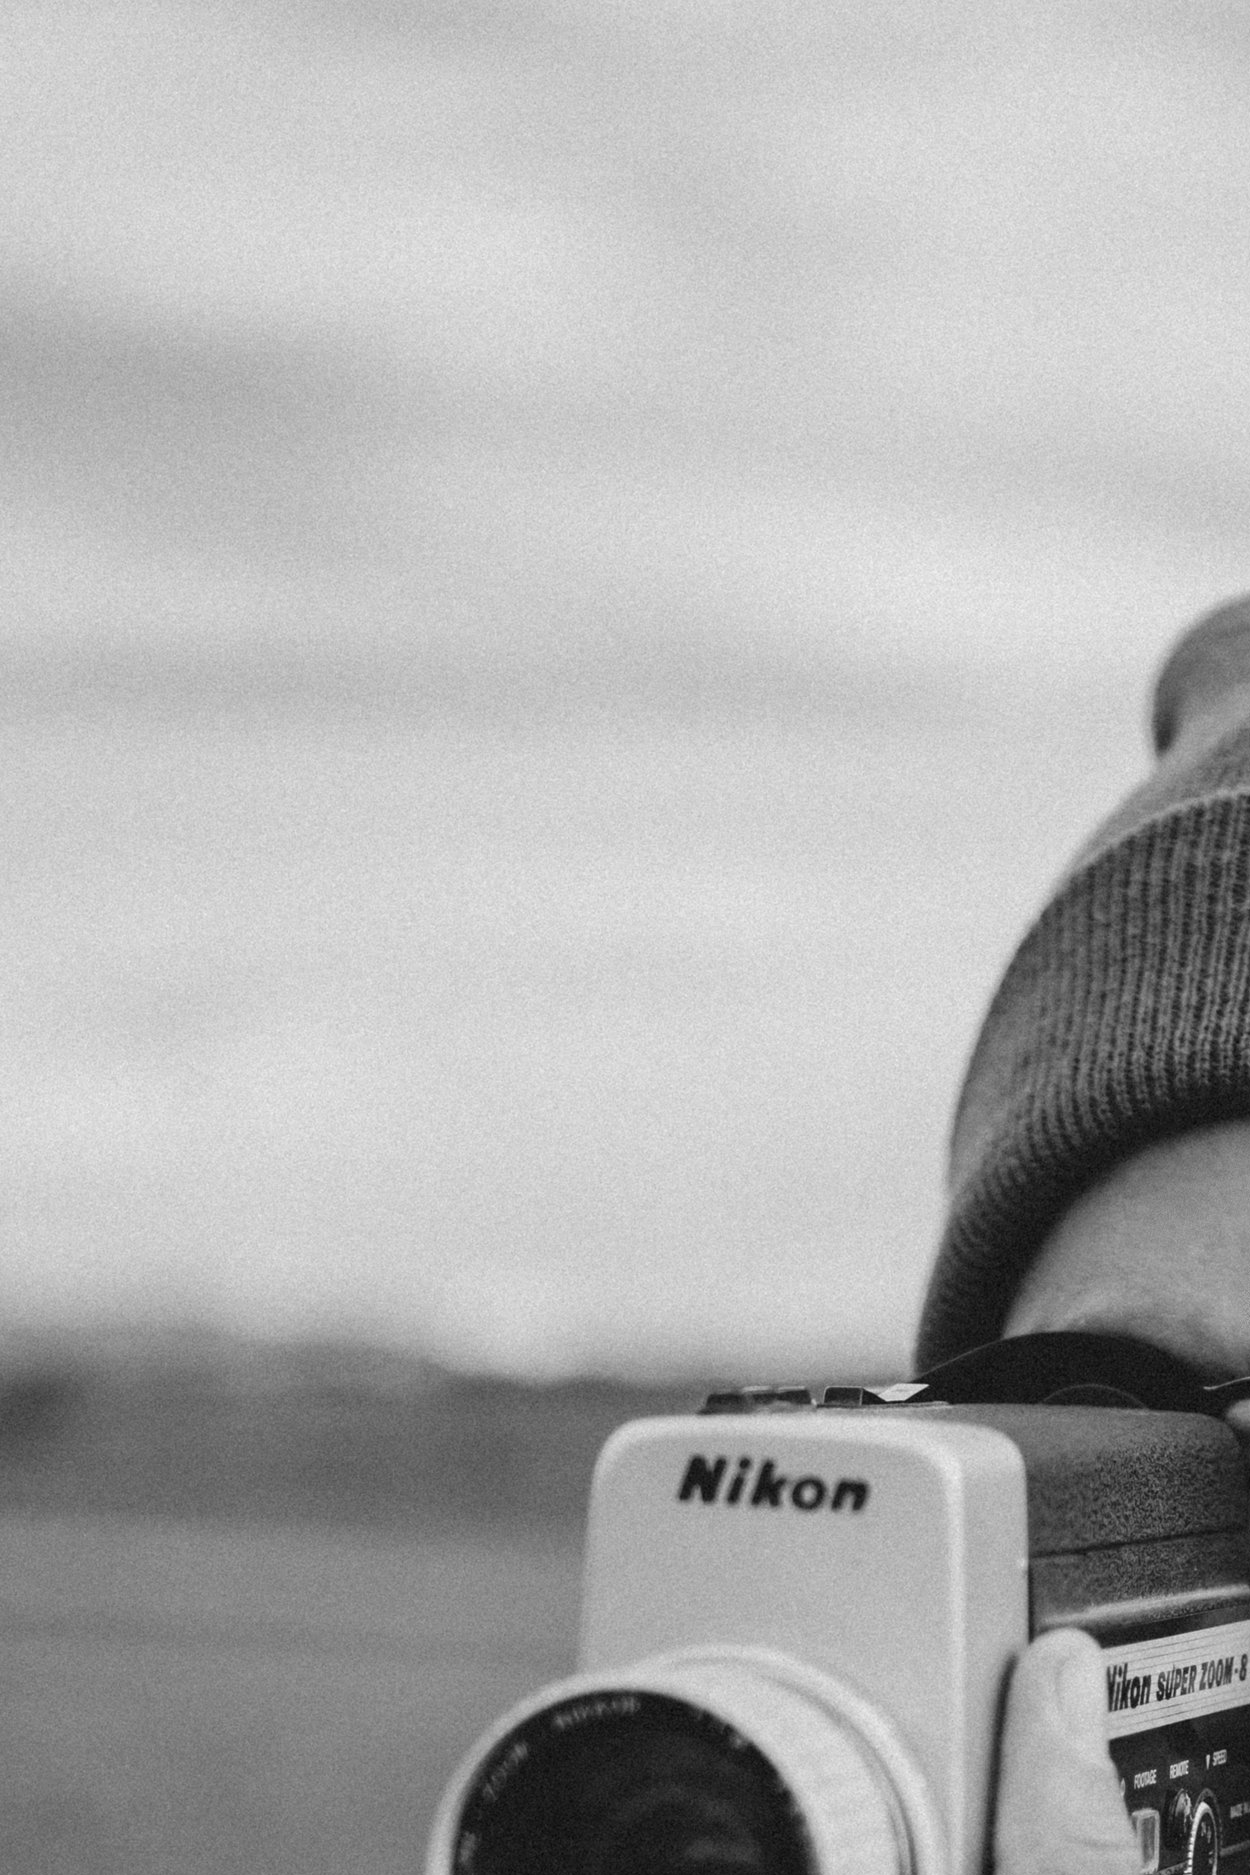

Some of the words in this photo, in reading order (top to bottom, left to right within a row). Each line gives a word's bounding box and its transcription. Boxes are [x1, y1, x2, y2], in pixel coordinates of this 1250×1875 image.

[678, 1455, 870, 1512] Nikon
[1156, 1665, 1197, 1701] SUPER
[1199, 1653, 1248, 1692] ZOOM-8
[1133, 1769, 1158, 1790] FOOTAGE
[1169, 1760, 1190, 1780] REMOTE
